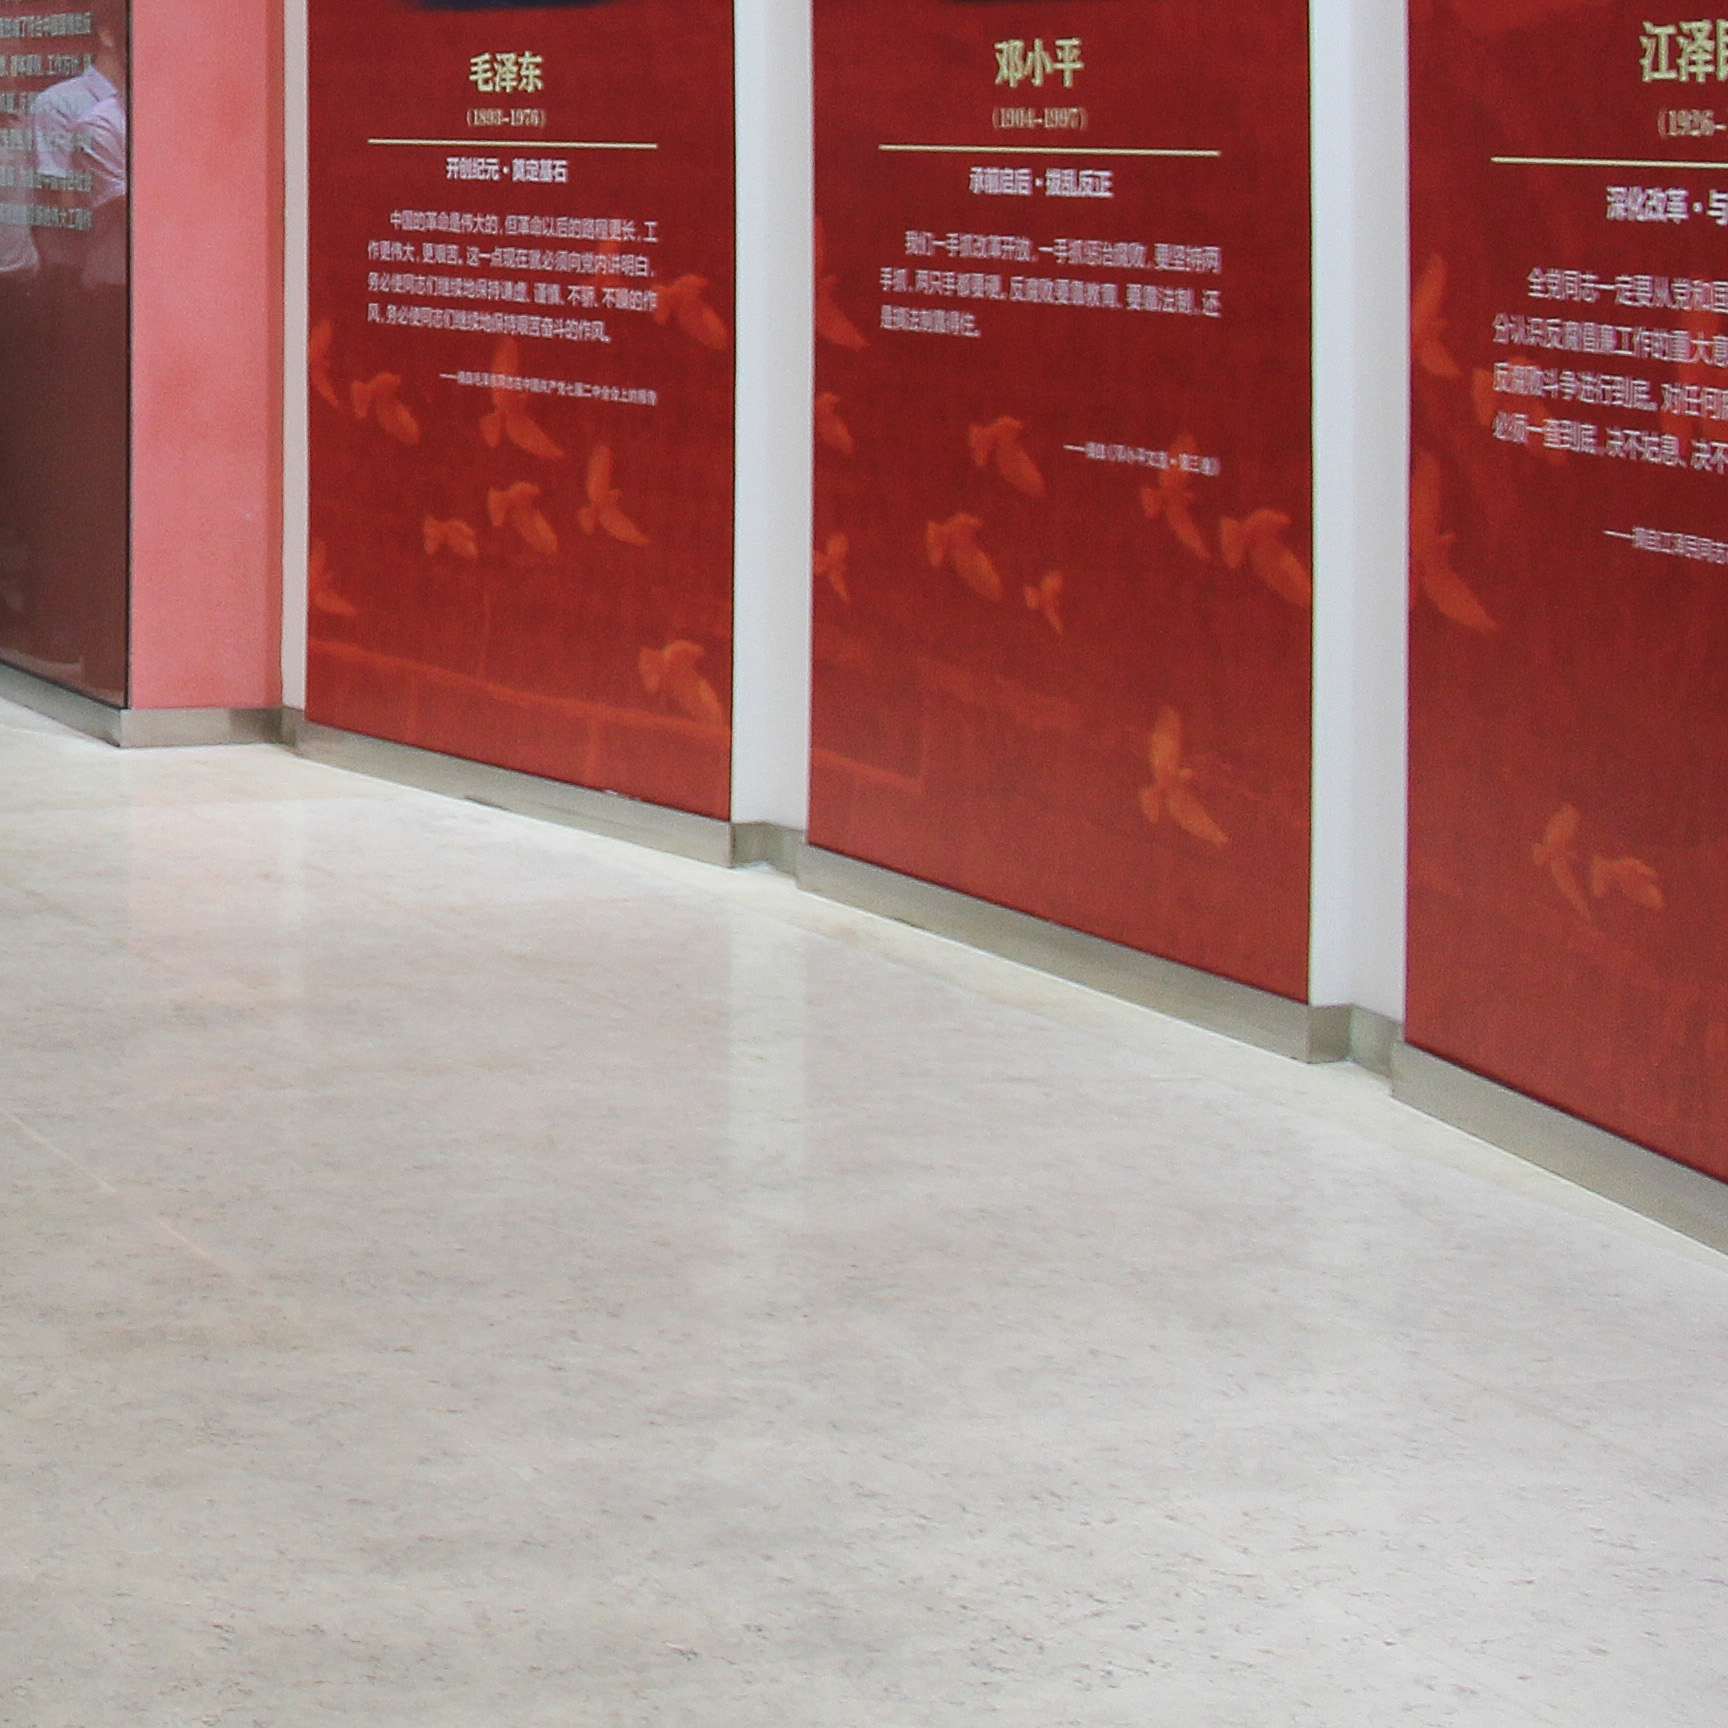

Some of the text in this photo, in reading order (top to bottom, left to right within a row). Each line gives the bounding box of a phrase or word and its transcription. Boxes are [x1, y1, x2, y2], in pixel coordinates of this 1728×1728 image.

[469, 51, 543, 93] 毛泽东
[994, 37, 1085, 88] 邓小平
